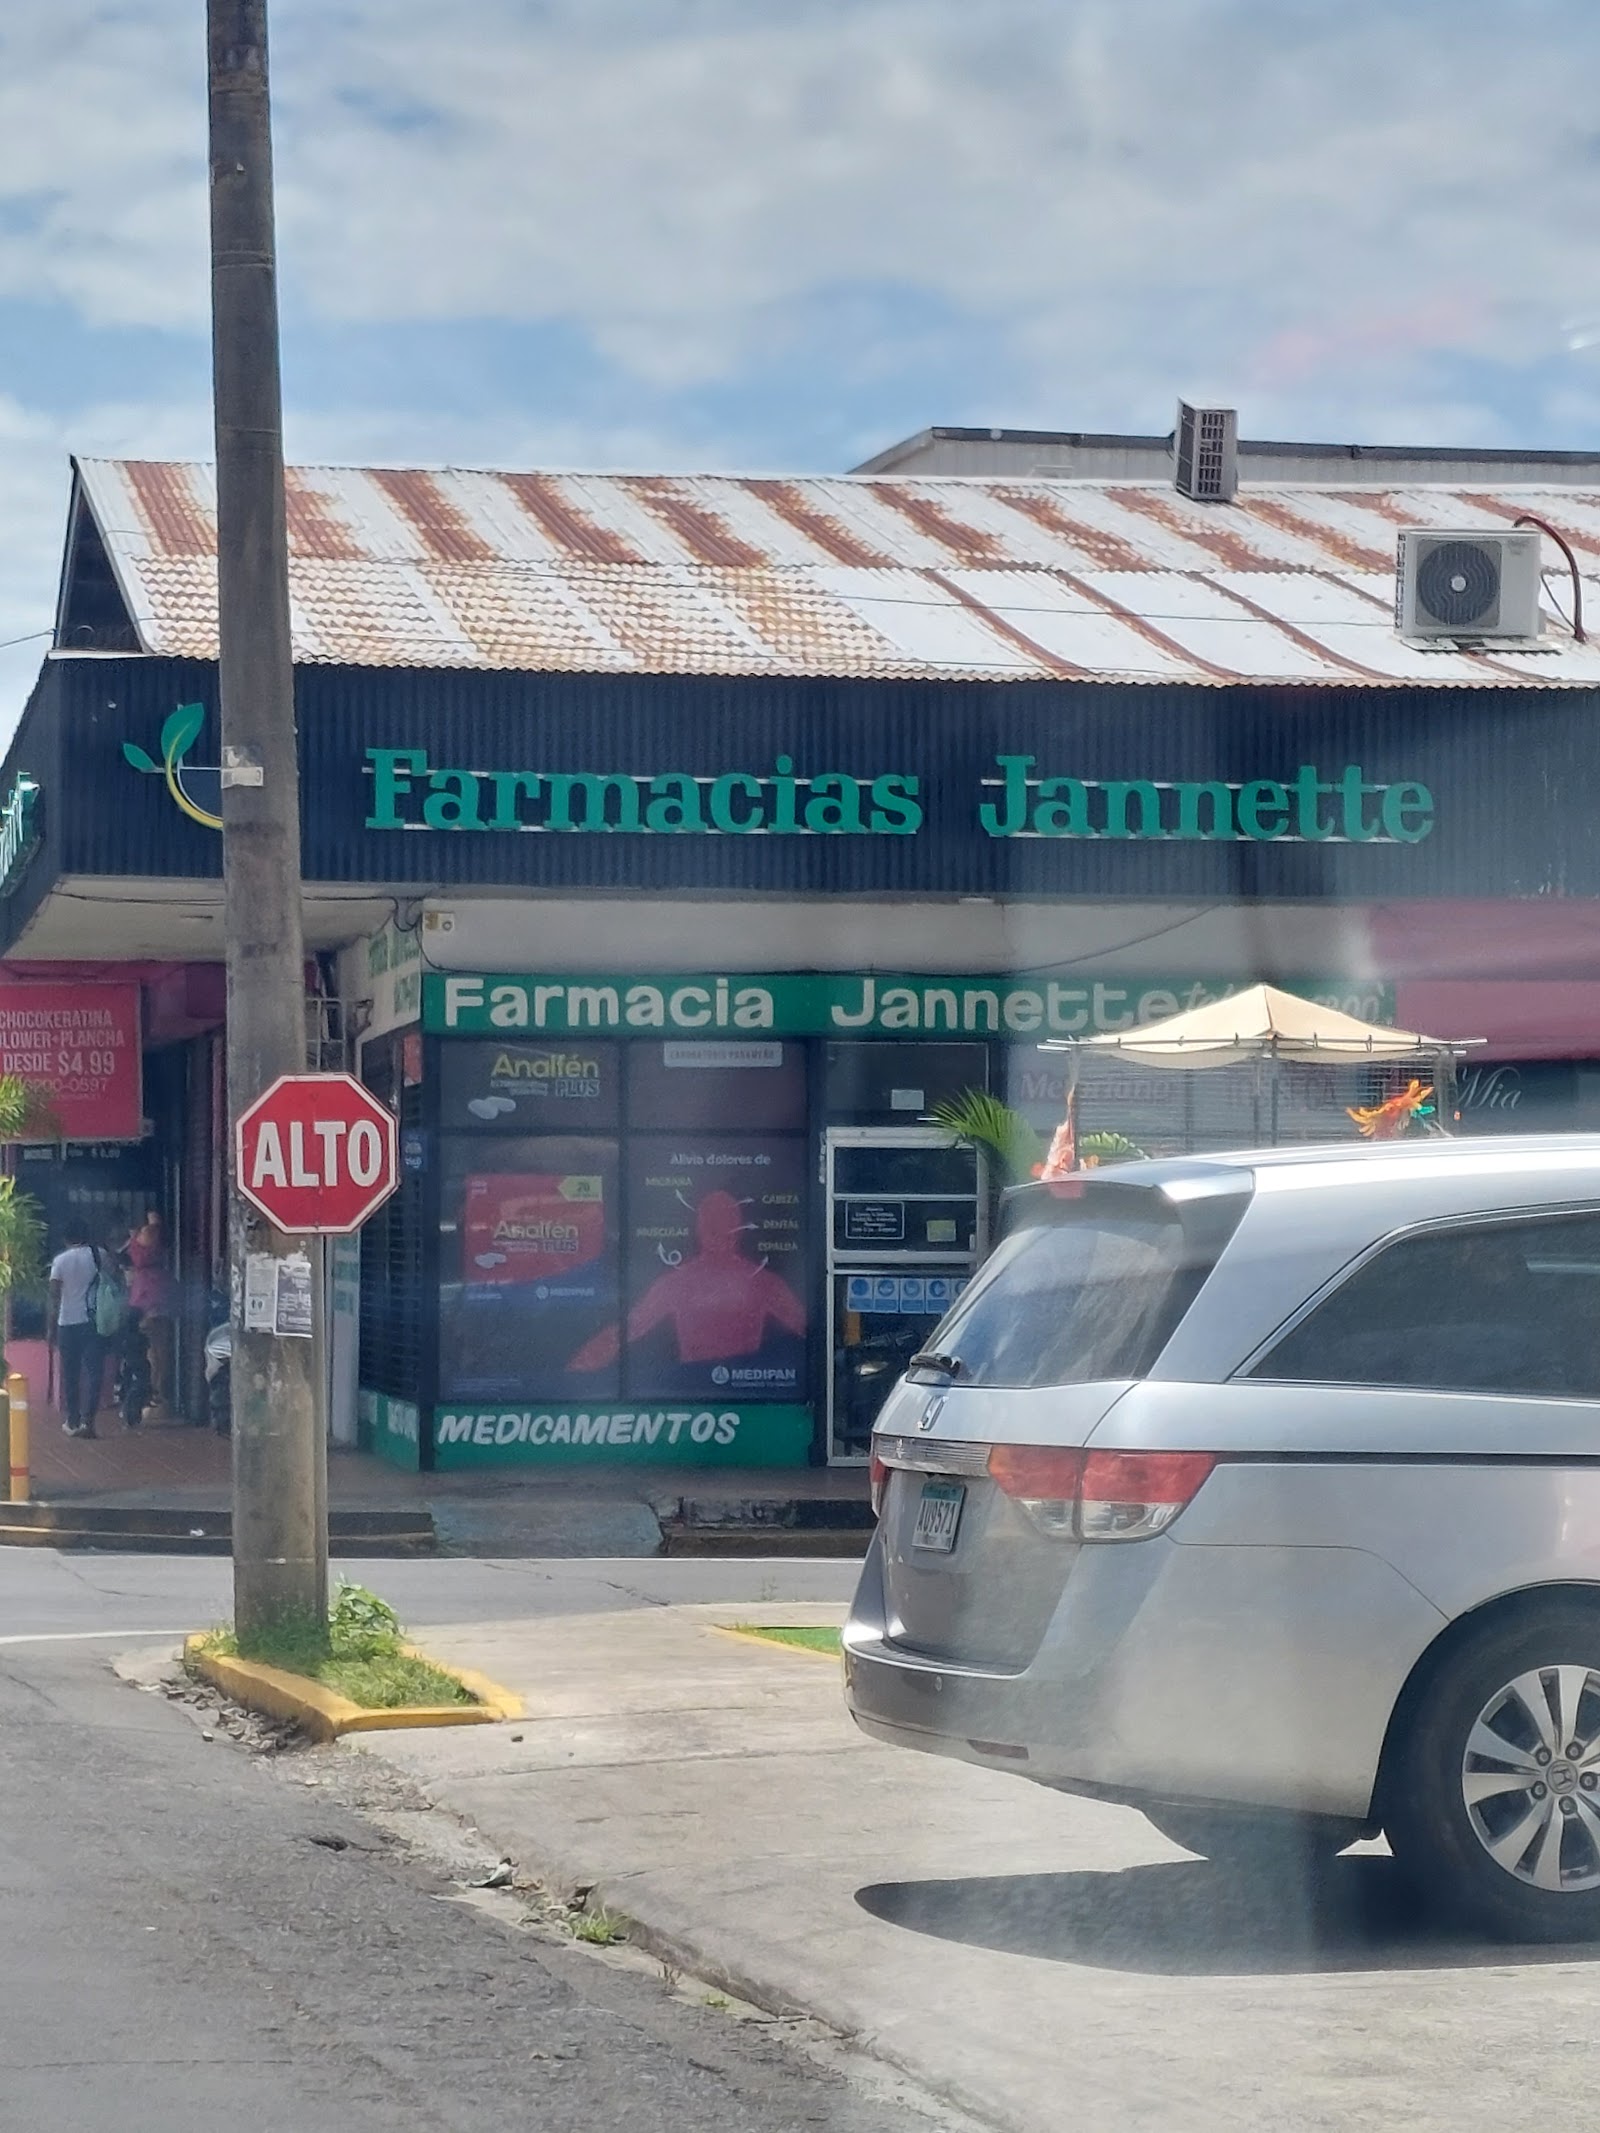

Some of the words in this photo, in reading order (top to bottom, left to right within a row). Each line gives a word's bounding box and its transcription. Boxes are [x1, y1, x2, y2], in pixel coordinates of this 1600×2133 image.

[364, 747, 924, 838] Farmacias
[979, 755, 1435, 844] Jannette
[445, 978, 774, 1027] Farmacia
[831, 979, 1180, 1031] Jannette
[3, 1053, 52, 1073] DESDE
[58, 1051, 115, 1076] $4.99
[491, 1053, 599, 1078] Analfén
[556, 1080, 599, 1097] PLUS
[251, 1119, 382, 1189] ALTO
[706, 1154, 751, 1166] dolores
[754, 1154, 771, 1166] de
[731, 1369, 796, 1380] MEDIPAN
[437, 1411, 740, 1446] MEDICAMENTOS
